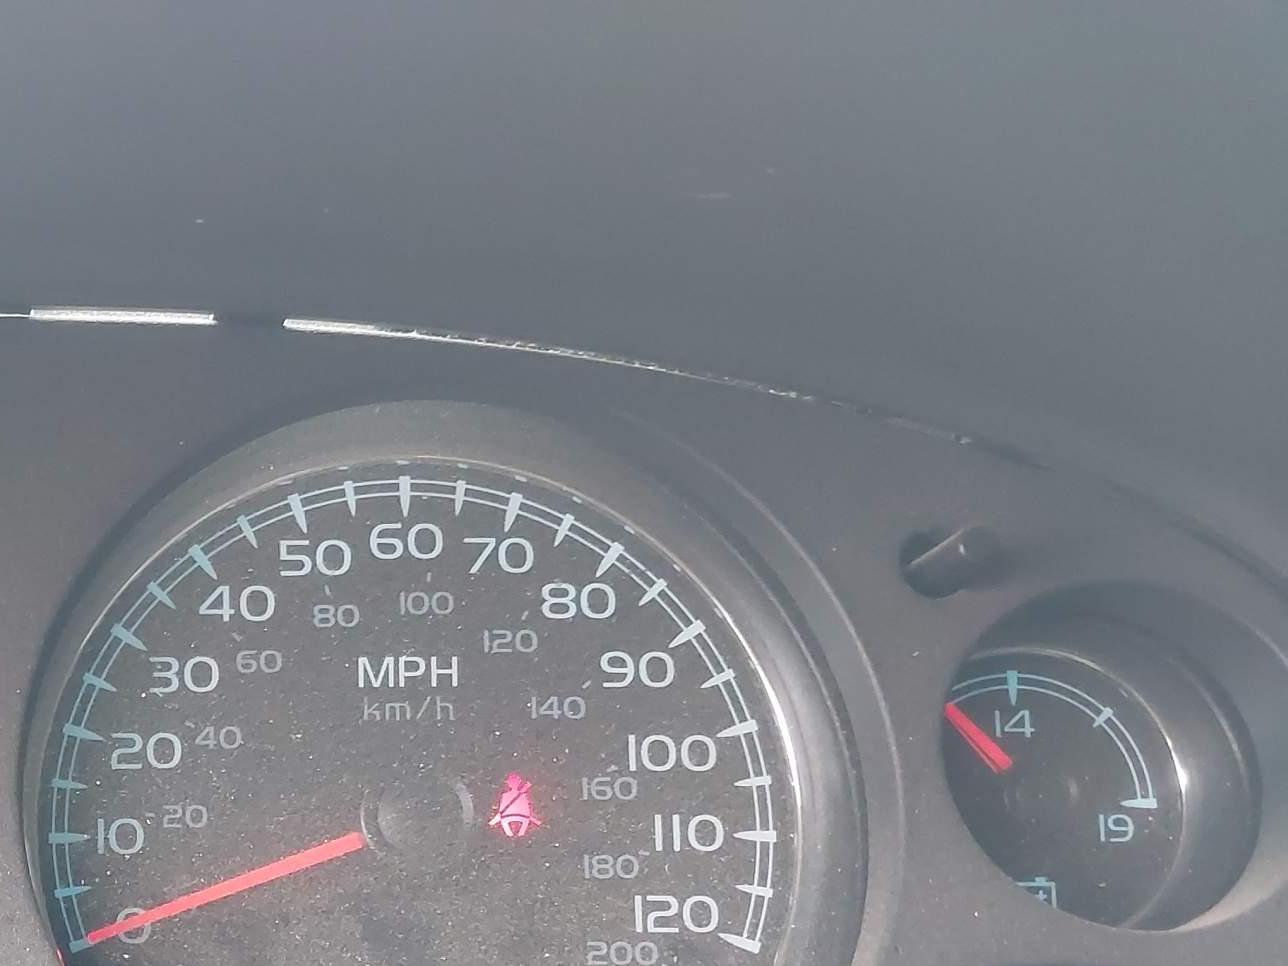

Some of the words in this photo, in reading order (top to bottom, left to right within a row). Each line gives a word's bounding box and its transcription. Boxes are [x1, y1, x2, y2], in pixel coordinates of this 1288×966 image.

[368, 523, 444, 559] 60
[463, 538, 535, 574] 70
[278, 539, 352, 576] 50
[198, 585, 276, 621] 40
[313, 604, 360, 627] 80
[399, 592, 455, 614] 100
[540, 583, 616, 619] 80
[483, 630, 538, 653] 120
[149, 656, 220, 693] 30
[235, 650, 283, 673] 60
[357, 656, 460, 687] MPH
[599, 651, 675, 688] 90
[363, 697, 455, 720] km/h
[530, 696, 586, 719] 140
[195, 726, 243, 749] 40
[994, 709, 1035, 738] 14
[111, 733, 182, 769] 20
[627, 735, 717, 771] 100
[582, 777, 638, 800] 160
[162, 805, 209, 828] 20
[1098, 813, 1134, 842] 19
[96, 818, 145, 854] 10
[654, 814, 724, 852] 110
[583, 855, 640, 879] 180
[115, 907, 152, 944] 0
[634, 895, 719, 933] 120
[586, 941, 658, 965] 200
